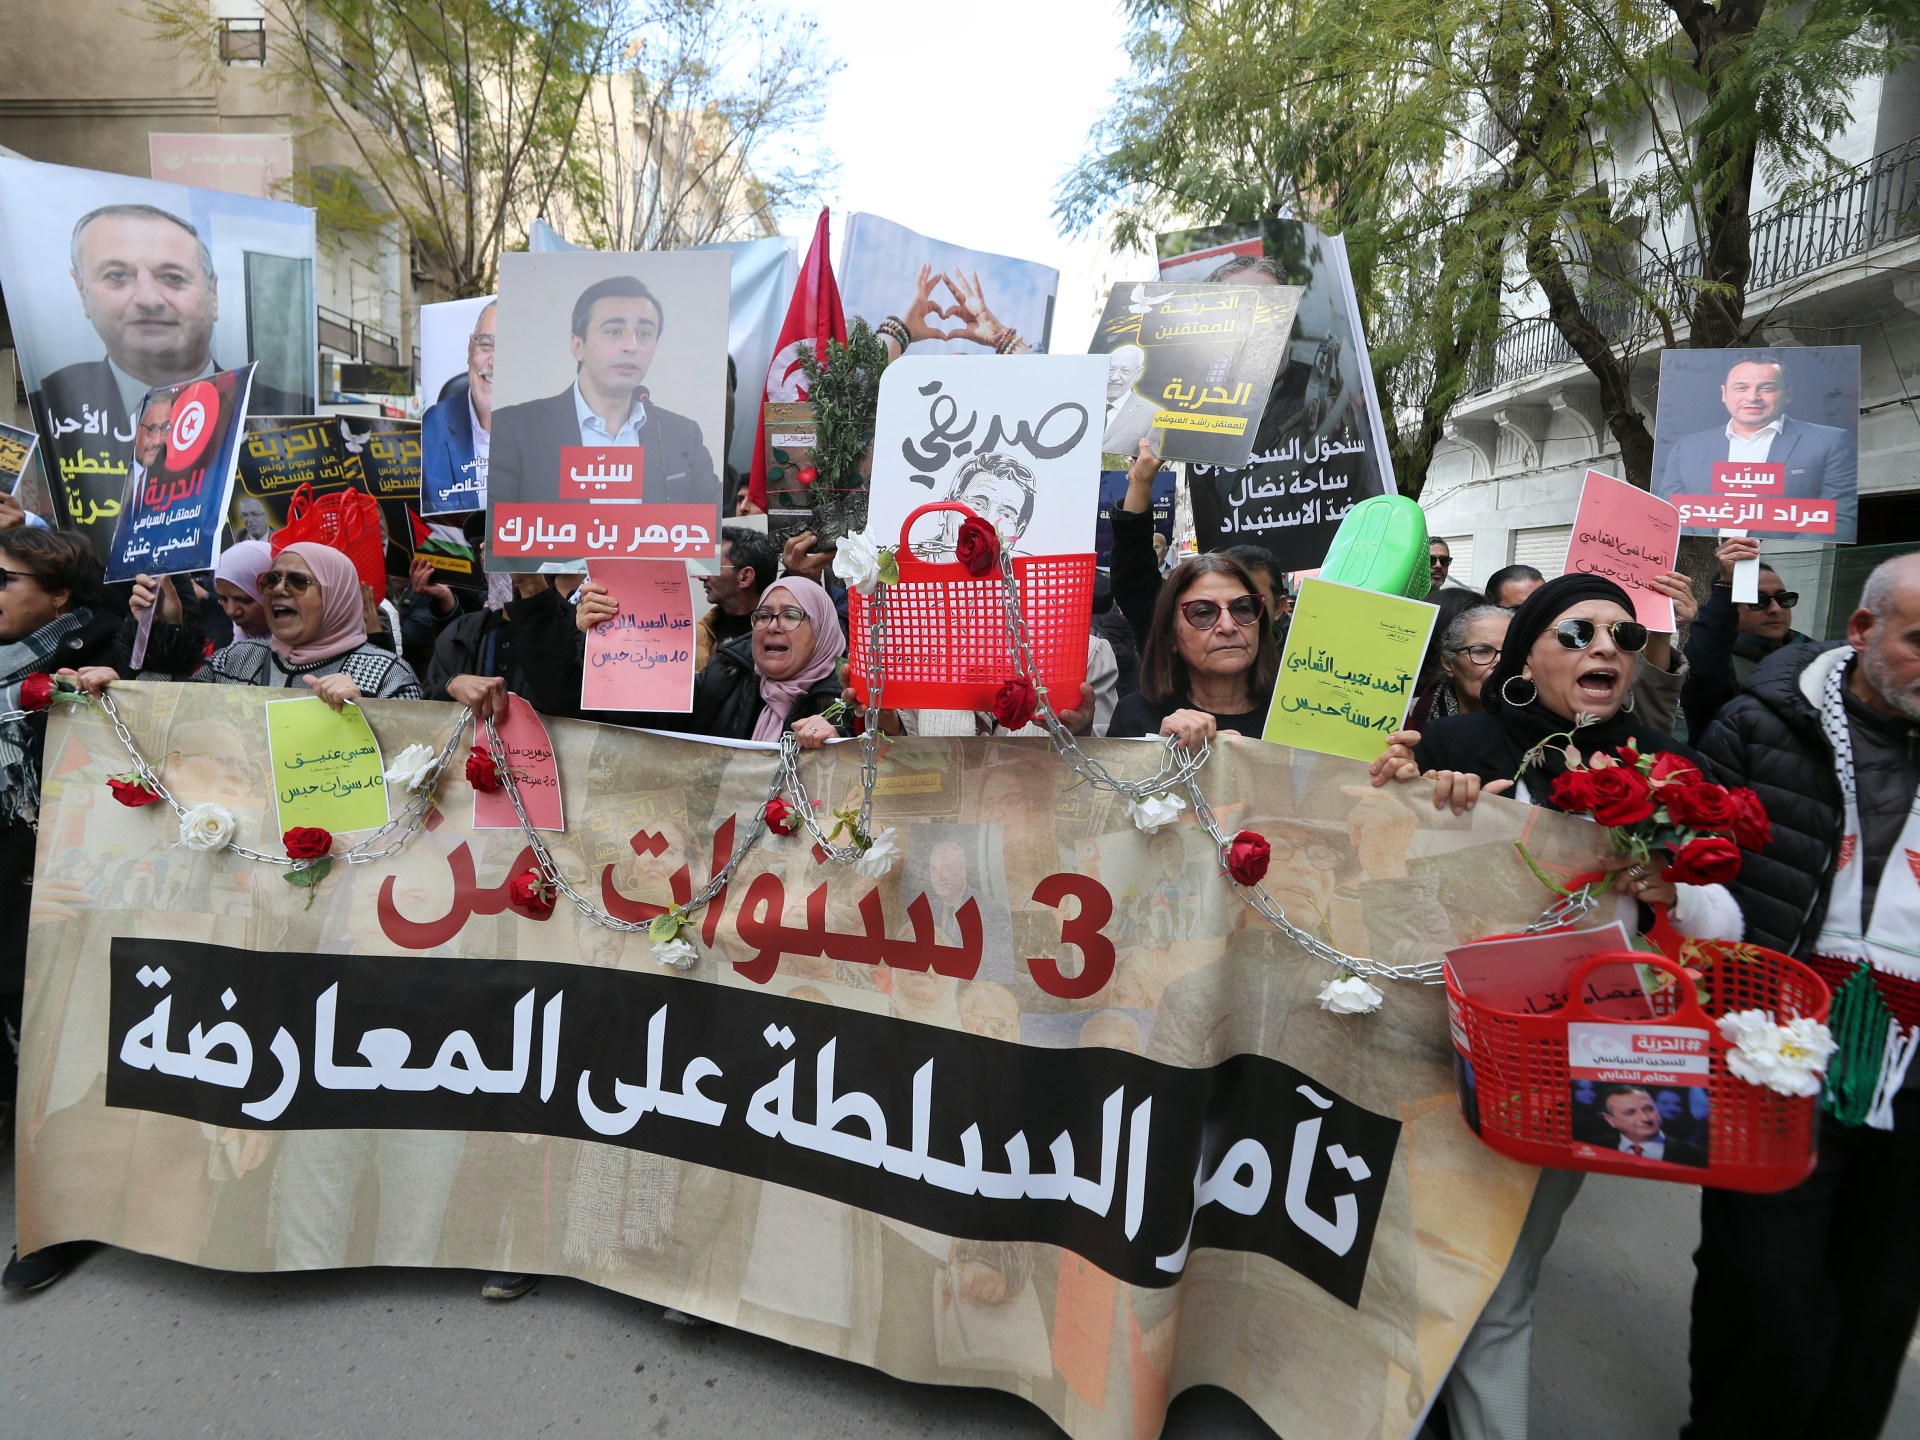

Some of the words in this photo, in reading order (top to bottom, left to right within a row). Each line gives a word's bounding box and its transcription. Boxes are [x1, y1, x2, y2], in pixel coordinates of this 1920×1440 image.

[1160, 296, 1239, 315] الحرية
[1162, 377, 1253, 410] الحرية
[48, 403, 107, 440] الأحرا
[1154, 414, 1188, 425] الغنوشي
[1190, 416, 1210, 428] راشد
[1212, 419, 1245, 430] للمعتقل
[248, 427, 330, 461] الحرية
[370, 435, 421, 464] حرية
[1224, 437, 1299, 473] السج
[259, 462, 285, 474] تونس
[288, 457, 315, 472] سجون
[321, 454, 337, 465] من
[259, 470, 315, 491] فلسطين
[320, 465, 345, 480] إلى
[570, 454, 632, 490] سيّب
[1289, 468, 1348, 495] ساحة
[1720, 466, 1775, 489] سيّب
[143, 469, 205, 511] الحرية
[438, 476, 487, 500] لجلاصي
[1228, 474, 1285, 507] نضال
[133, 511, 166, 533] السياسي
[166, 504, 202, 526] للمعتقل
[1221, 498, 1320, 536] الاستبداد
[1679, 502, 1763, 525] الزغيدي
[1773, 505, 1829, 528] مراد
[498, 517, 576, 552] مبارك
[586, 519, 618, 551] بن
[627, 524, 710, 552] جوهر
[122, 537, 151, 563] عتيق
[1576, 559, 1616, 577] حبس
[1617, 573, 1655, 592] سنوات
[594, 613, 636, 637] الجلاصي
[637, 613, 669, 632] الحميد
[670, 618, 692, 630] عبد
[592, 651, 629, 667] حبس
[630, 647, 668, 669] سنوات
[1334, 670, 1373, 687] نجيب
[1372, 672, 1413, 695] أحمد
[1281, 694, 1342, 717] حبس
[1340, 702, 1371, 729] سنة
[1371, 714, 1399, 735] 12
[285, 749, 341, 770] عتيق
[507, 742, 520, 757] مبا
[280, 784, 319, 804] حبس
[320, 776, 362, 798] سنوات
[377, 808, 556, 950] من
[601, 813, 983, 985] سنوات
[1027, 872, 1116, 1000] 3
[119, 964, 563, 1122] المعارضة
[576, 1004, 727, 1136] على
[1642, 1072, 1678, 1083] عصام
[745, 1022, 1152, 1242] السلطة
[1156, 1084, 1371, 1274] تآمر
